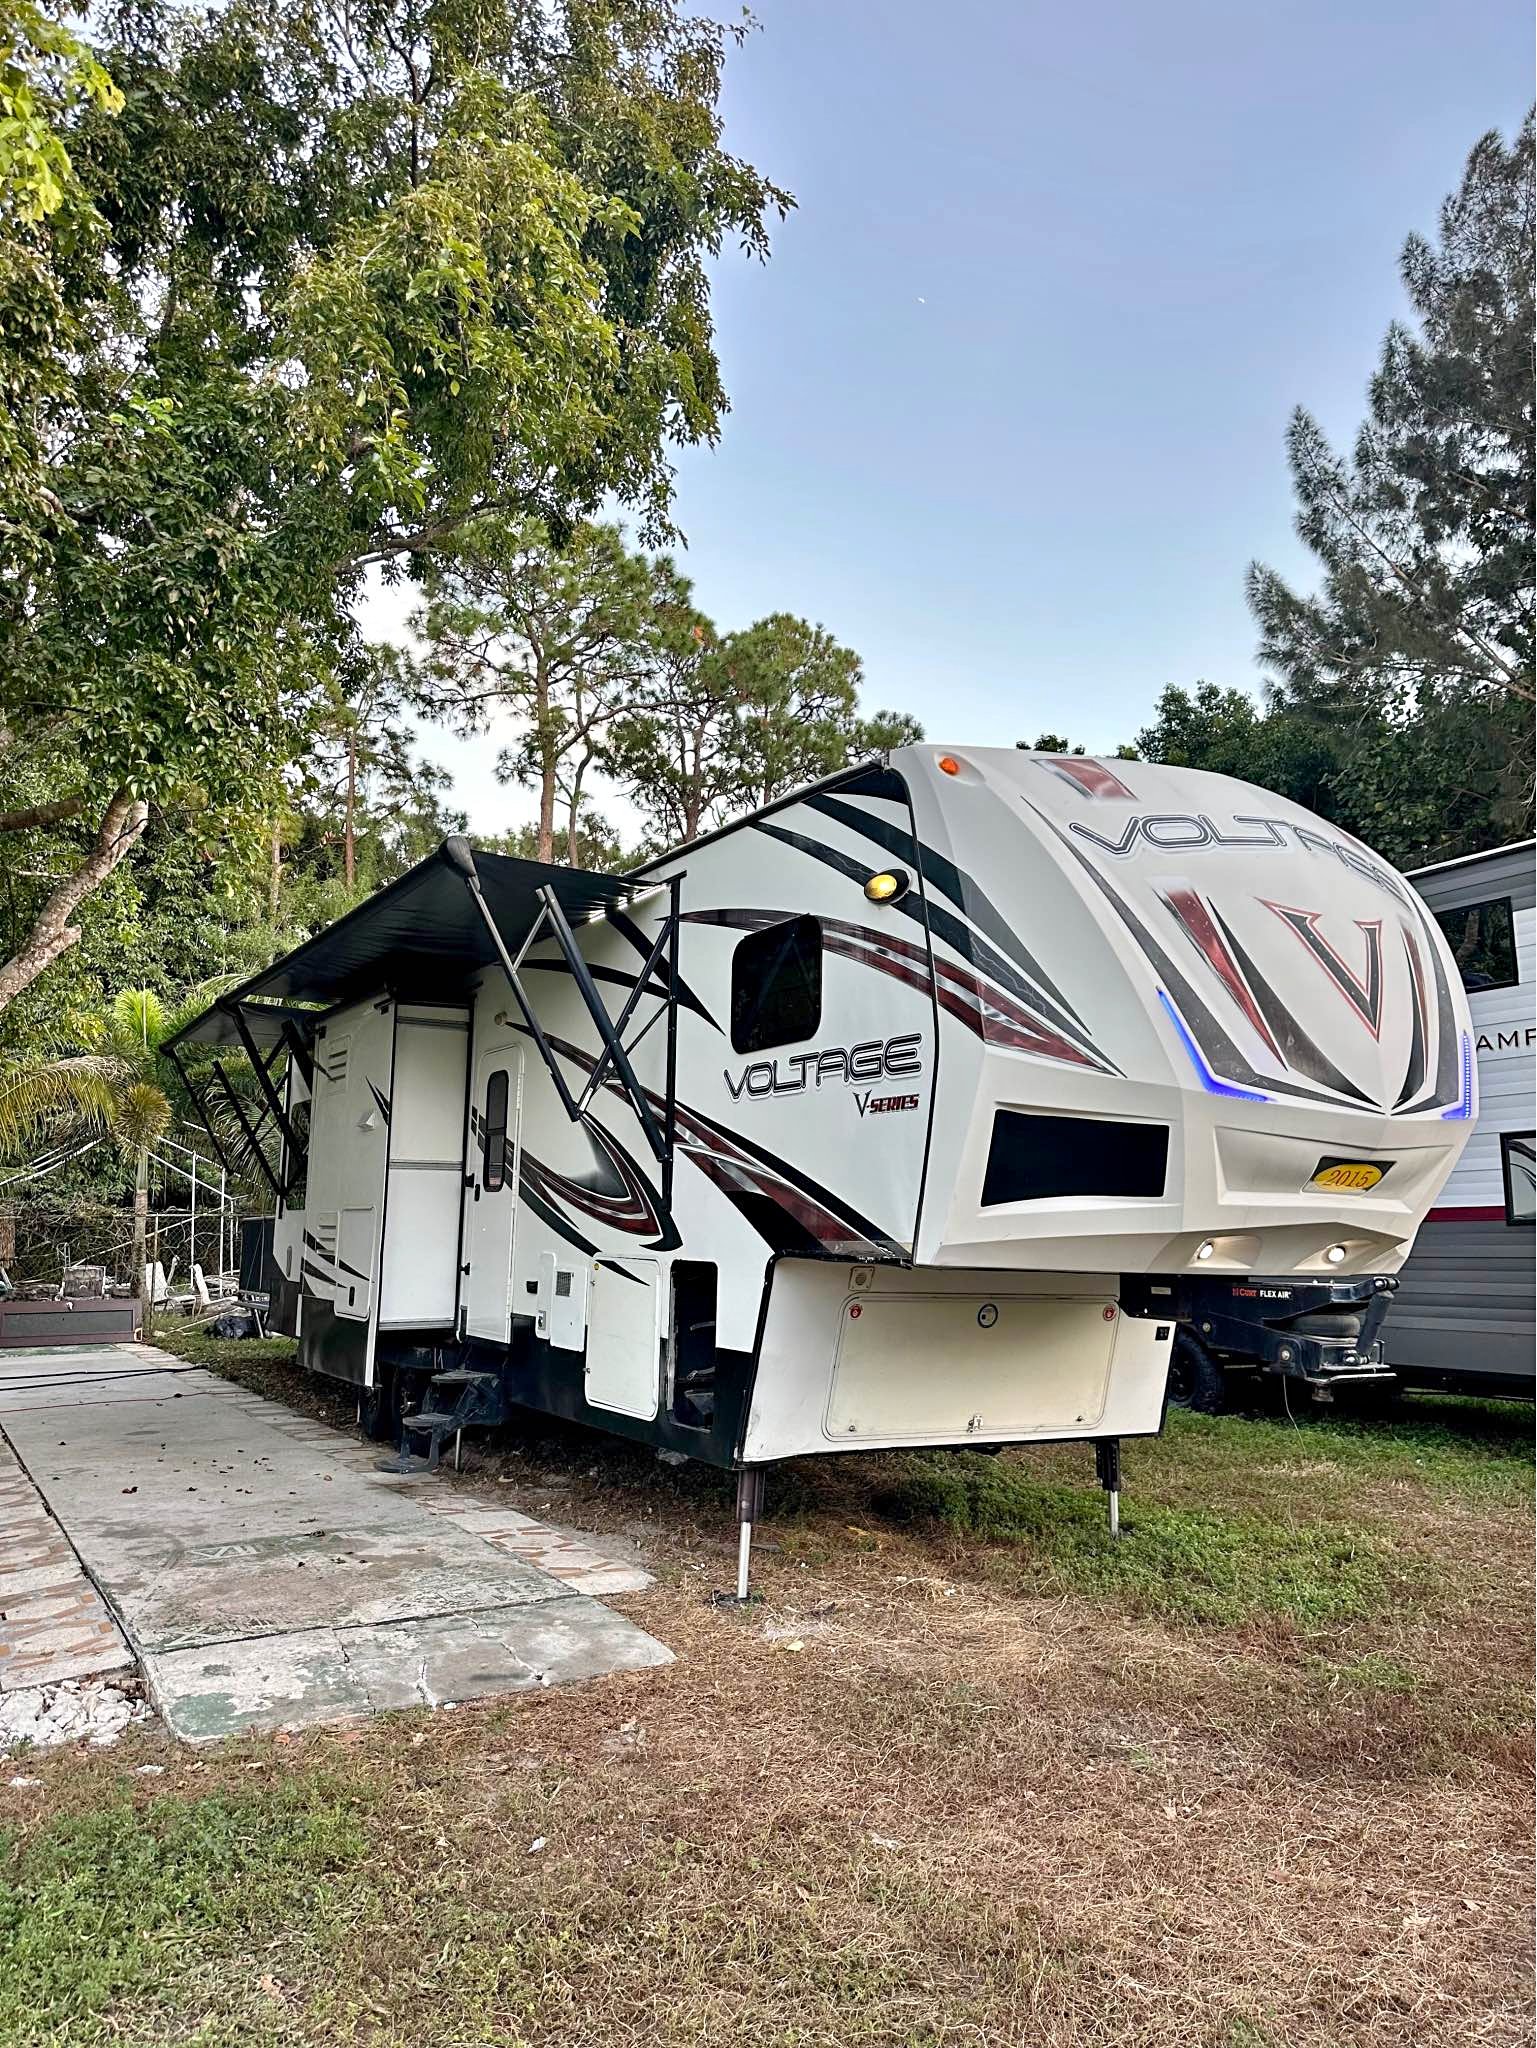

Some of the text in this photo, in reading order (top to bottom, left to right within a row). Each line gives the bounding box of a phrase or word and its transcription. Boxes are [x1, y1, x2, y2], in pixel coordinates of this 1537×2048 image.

[1069, 813, 1413, 913] VOLTAGE
[723, 1032, 922, 1101] VOLTAGE
[1322, 1169, 1374, 1188] 2015
[1260, 1289, 1276, 1298] FLEX
